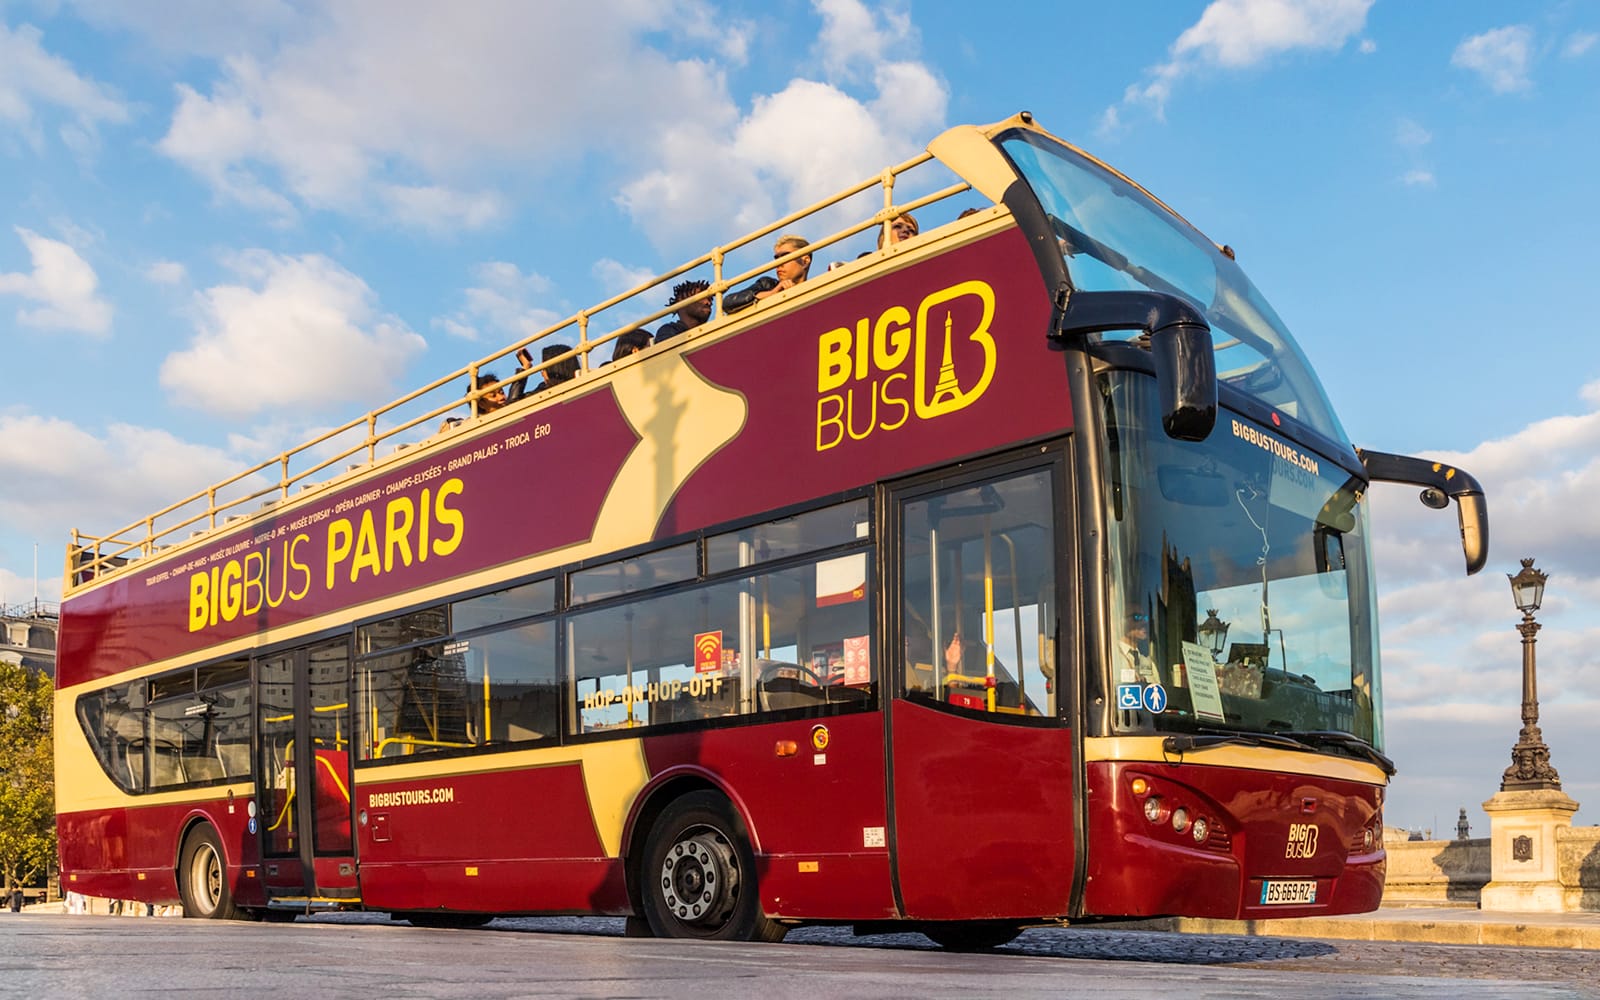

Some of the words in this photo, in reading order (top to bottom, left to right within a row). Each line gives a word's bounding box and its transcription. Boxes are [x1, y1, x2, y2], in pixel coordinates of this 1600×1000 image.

[817, 305, 912, 393] BIG
[816, 372, 910, 452] BUS
[1231, 419, 1319, 476] BIGBUSTOURS.COM
[289, 514, 309, 531] MUSÉE
[308, 508, 331, 525] D'ORSAY
[335, 499, 355, 514] OPÉRA
[448, 454, 473, 472] GRAND
[473, 443, 498, 462] PALAIS
[326, 477, 464, 590] PARIS
[584, 683, 644, 711] HOP-ON
[648, 672, 722, 703] HOP-OFF
[369, 787, 454, 808] BIGBUSTOURS.COM
[1285, 842, 1305, 859] BUS
[1288, 823, 1307, 841] BIG
